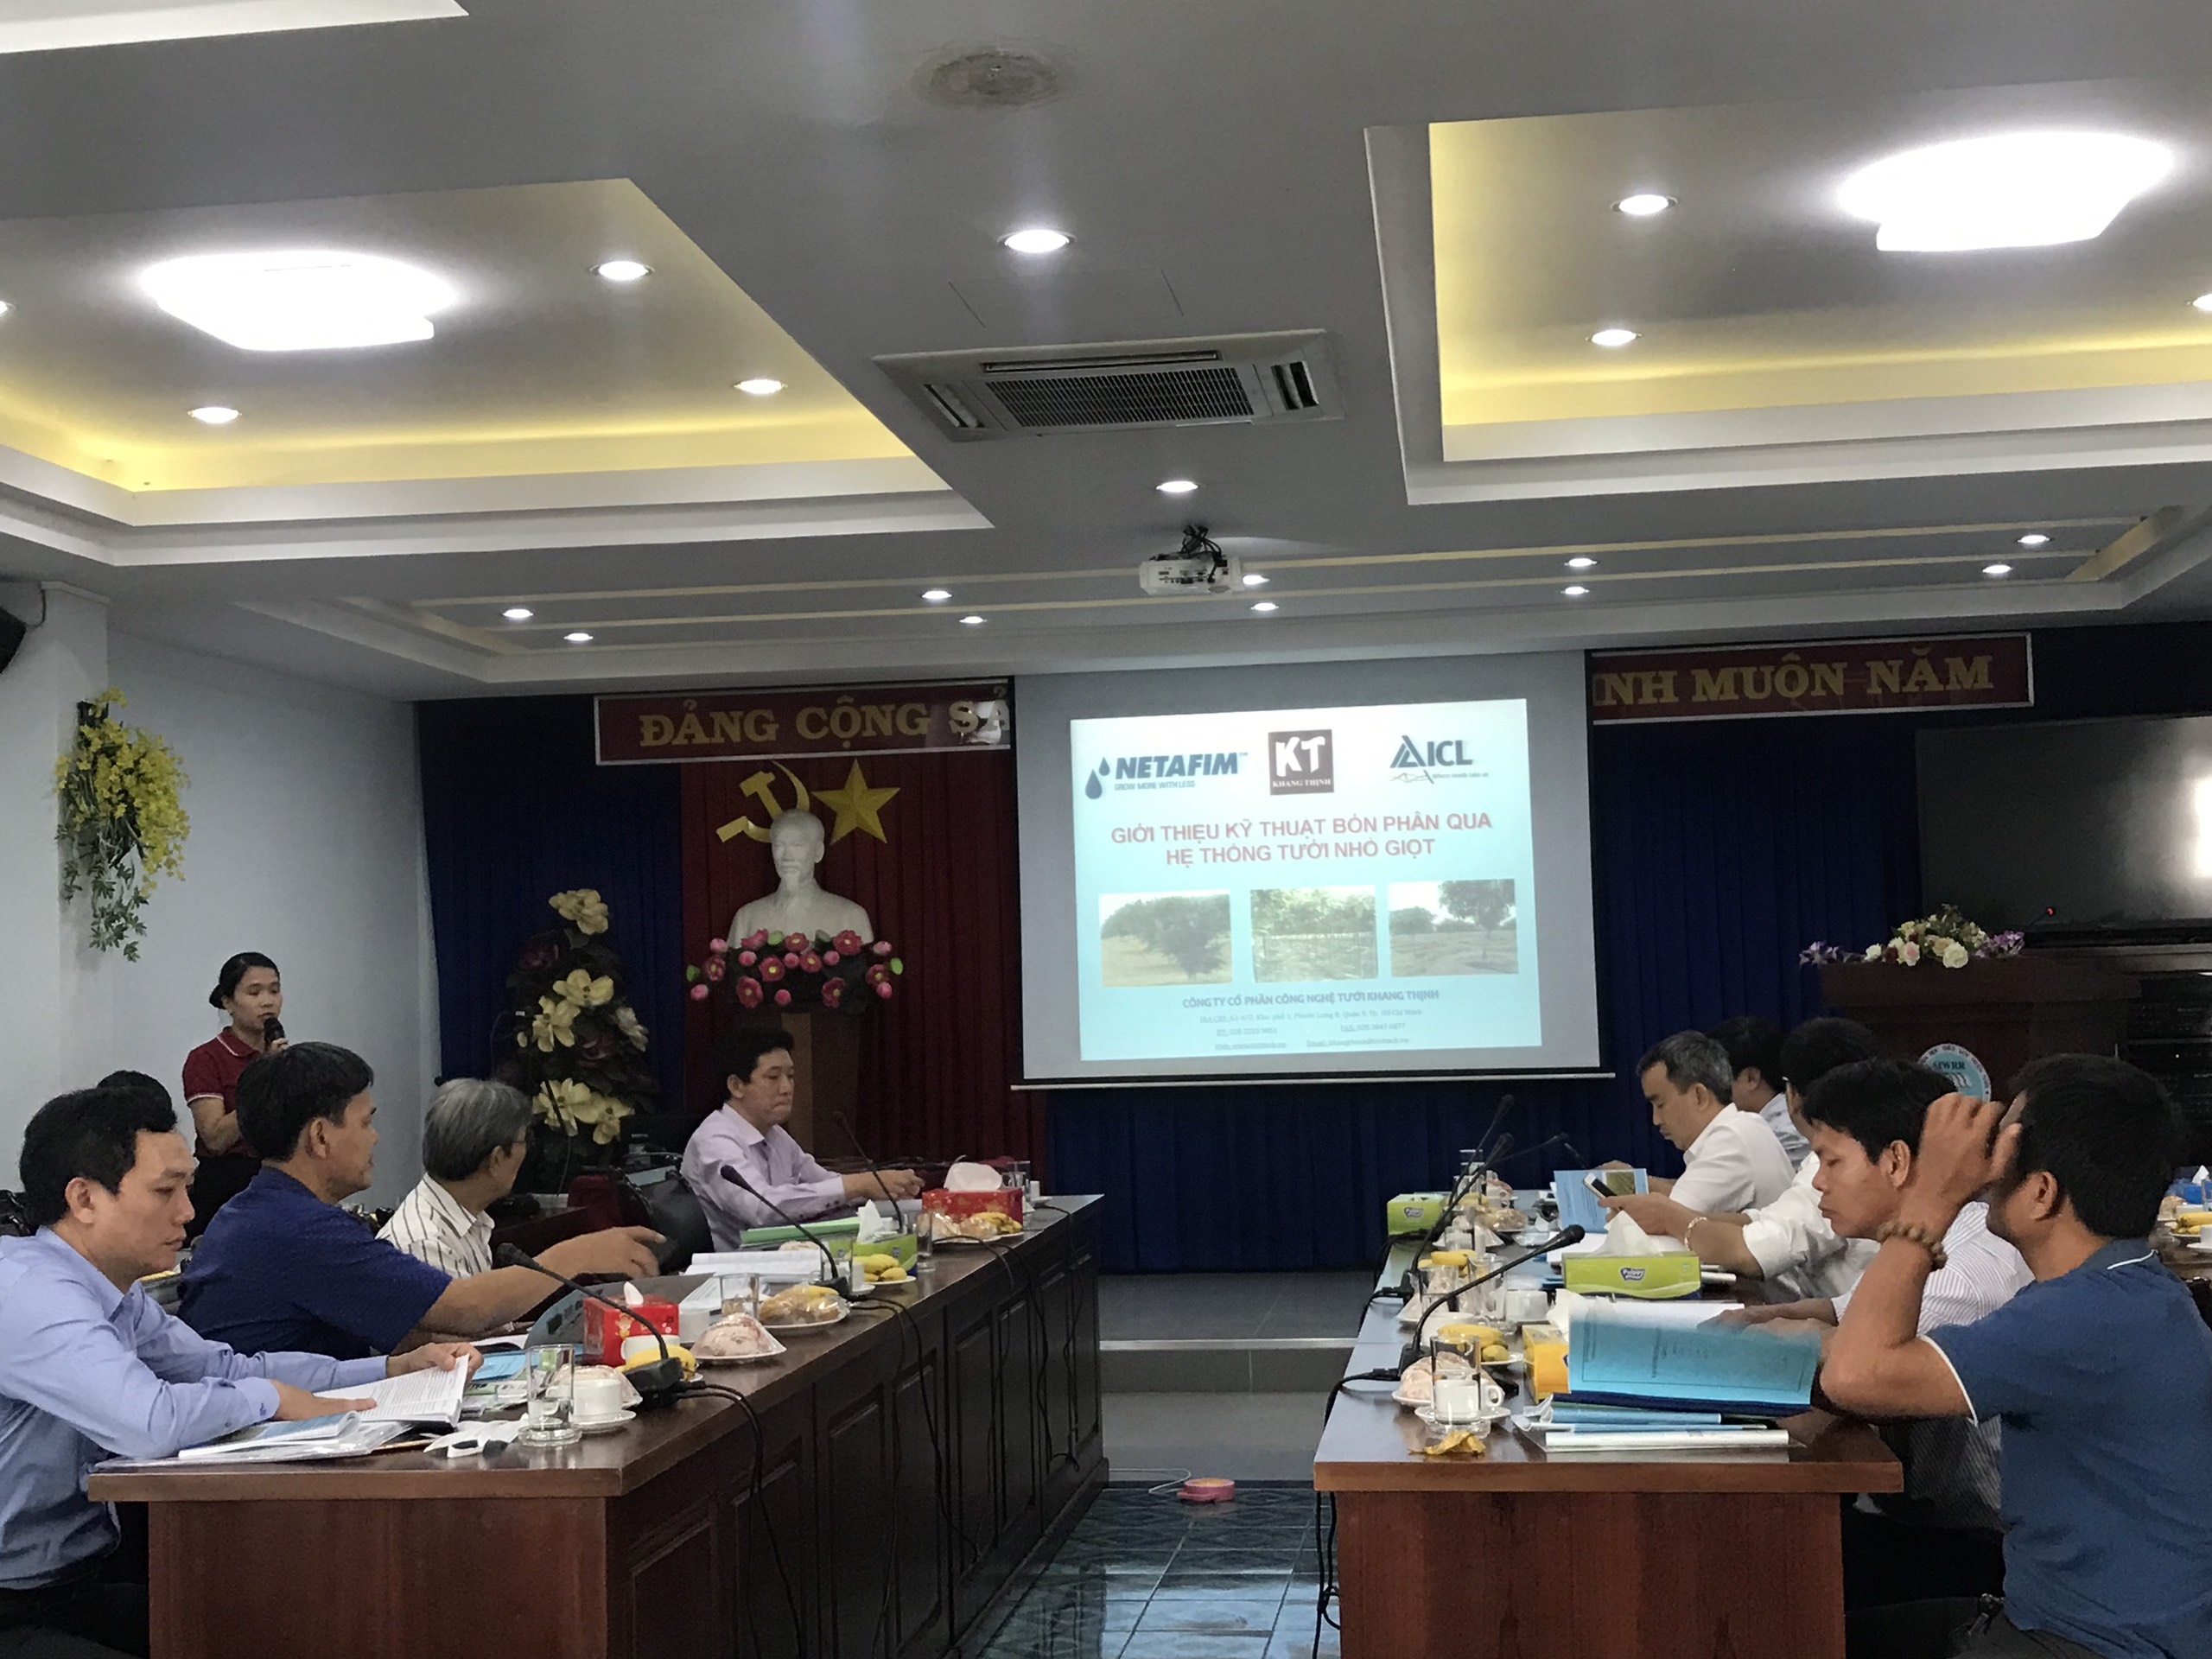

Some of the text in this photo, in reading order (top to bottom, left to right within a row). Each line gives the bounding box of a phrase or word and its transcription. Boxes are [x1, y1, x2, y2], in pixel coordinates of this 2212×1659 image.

[1593, 670, 1679, 706] NH
[1866, 646, 1994, 694] NĂM
[639, 699, 779, 747] ĐẢNG
[795, 695, 931, 748] CỘNG
[1115, 752, 1238, 779] NETAFIM
[1274, 735, 1325, 777] KT
[1272, 779, 1303, 788] KHANG
[1383, 810, 1440, 832] PHÂN
[1446, 812, 1492, 830] QUA
[1385, 838, 1435, 859] GIỌT
[1212, 997, 1226, 1007] TY
[1367, 990, 1404, 1001] KHANG
